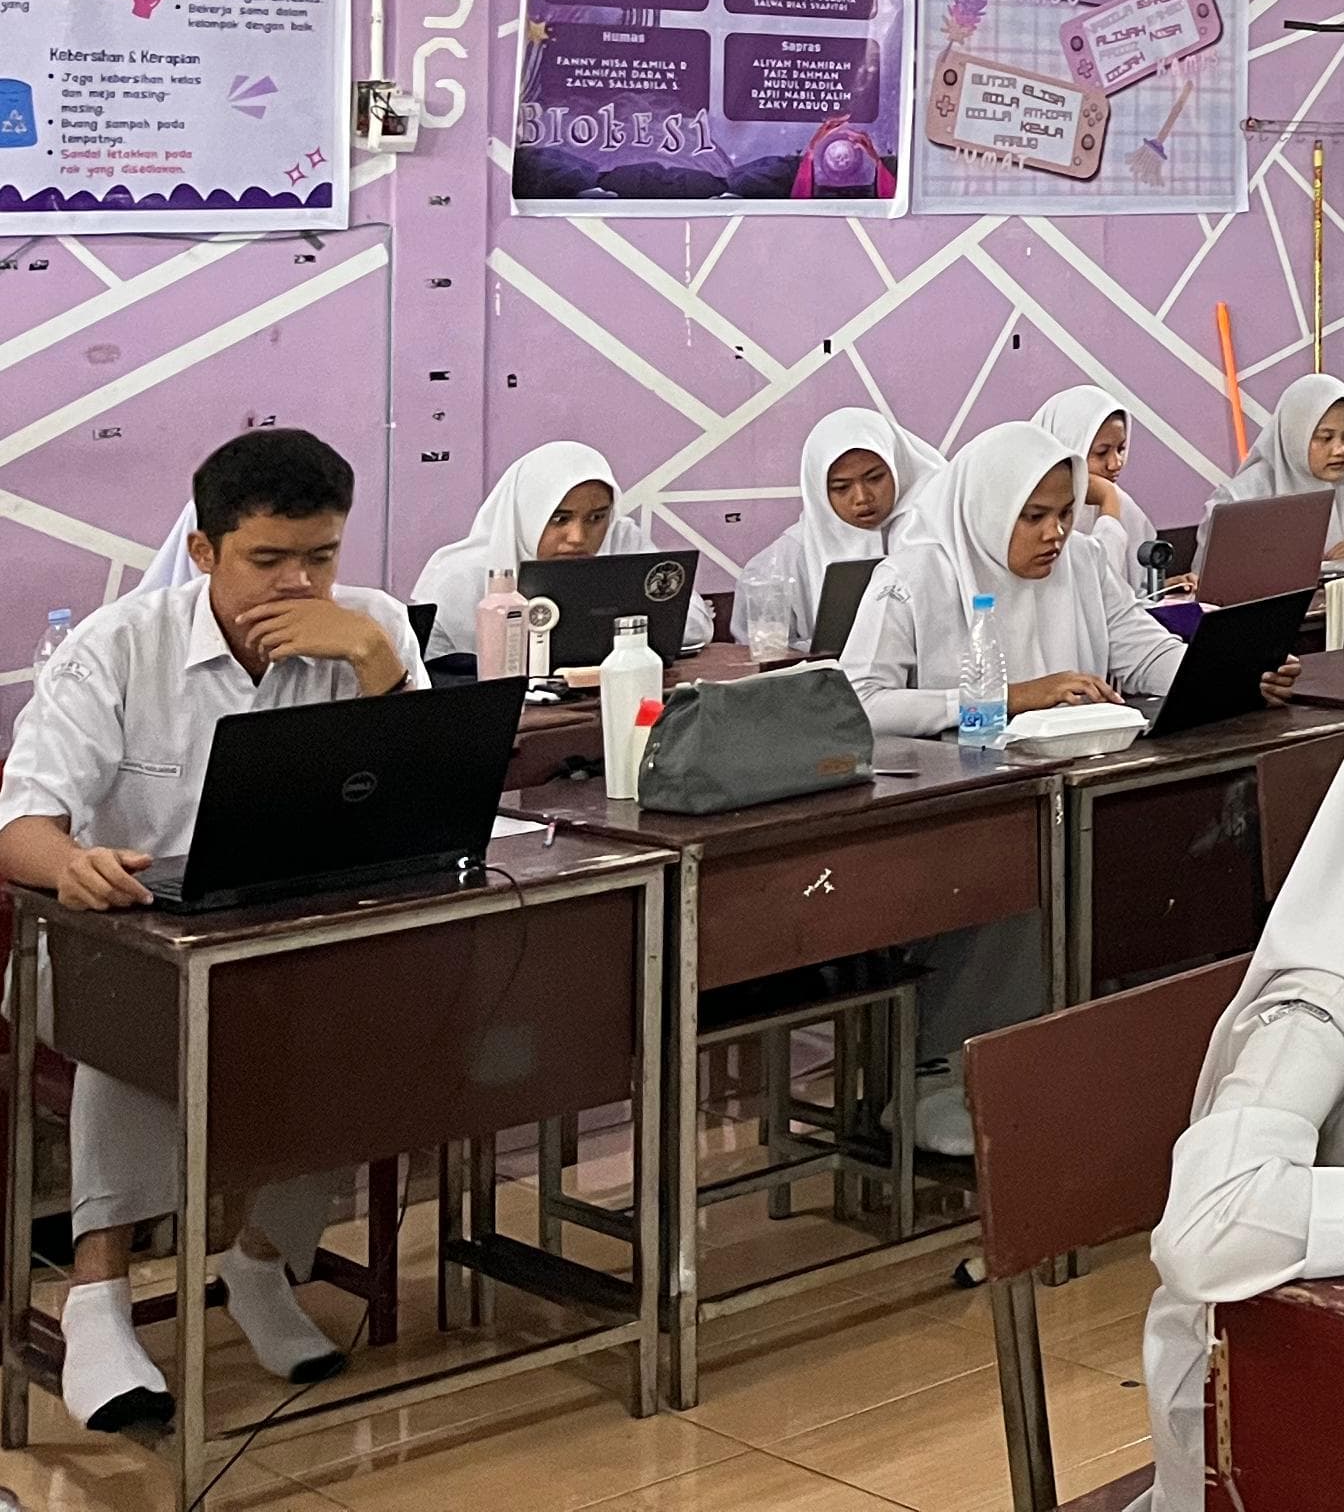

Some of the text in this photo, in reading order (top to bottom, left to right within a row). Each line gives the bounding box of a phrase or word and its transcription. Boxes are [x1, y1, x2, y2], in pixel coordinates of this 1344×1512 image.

[239, 6, 269, 16] sama
[245, 21, 285, 34] dengan
[602, 31, 646, 43] Humas
[781, 40, 821, 53] Sapras
[50, 48, 201, 66] Kebersihan & Kerapian
[556, 56, 676, 70] FANNY NISA KAMILA
[752, 59, 792, 68] ALIYAH
[61, 72, 201, 86] Jaga kebersihan kelas
[764, 70, 839, 80] FAIZ RAHMAN
[608, 79, 668, 90] SALSABILA
[764, 80, 800, 89] NURUL
[61, 89, 171, 103] dan meja masing-
[785, 91, 815, 100] NABIL
[758, 99, 828, 112] ZAKY FARUQ
[61, 118, 185, 131] Buang sampah pada
[60, 149, 101, 159] Sandal
[165, 150, 193, 160] pada
[950, 147, 1029, 169] JUMAT
[86, 166, 114, 178] yang
